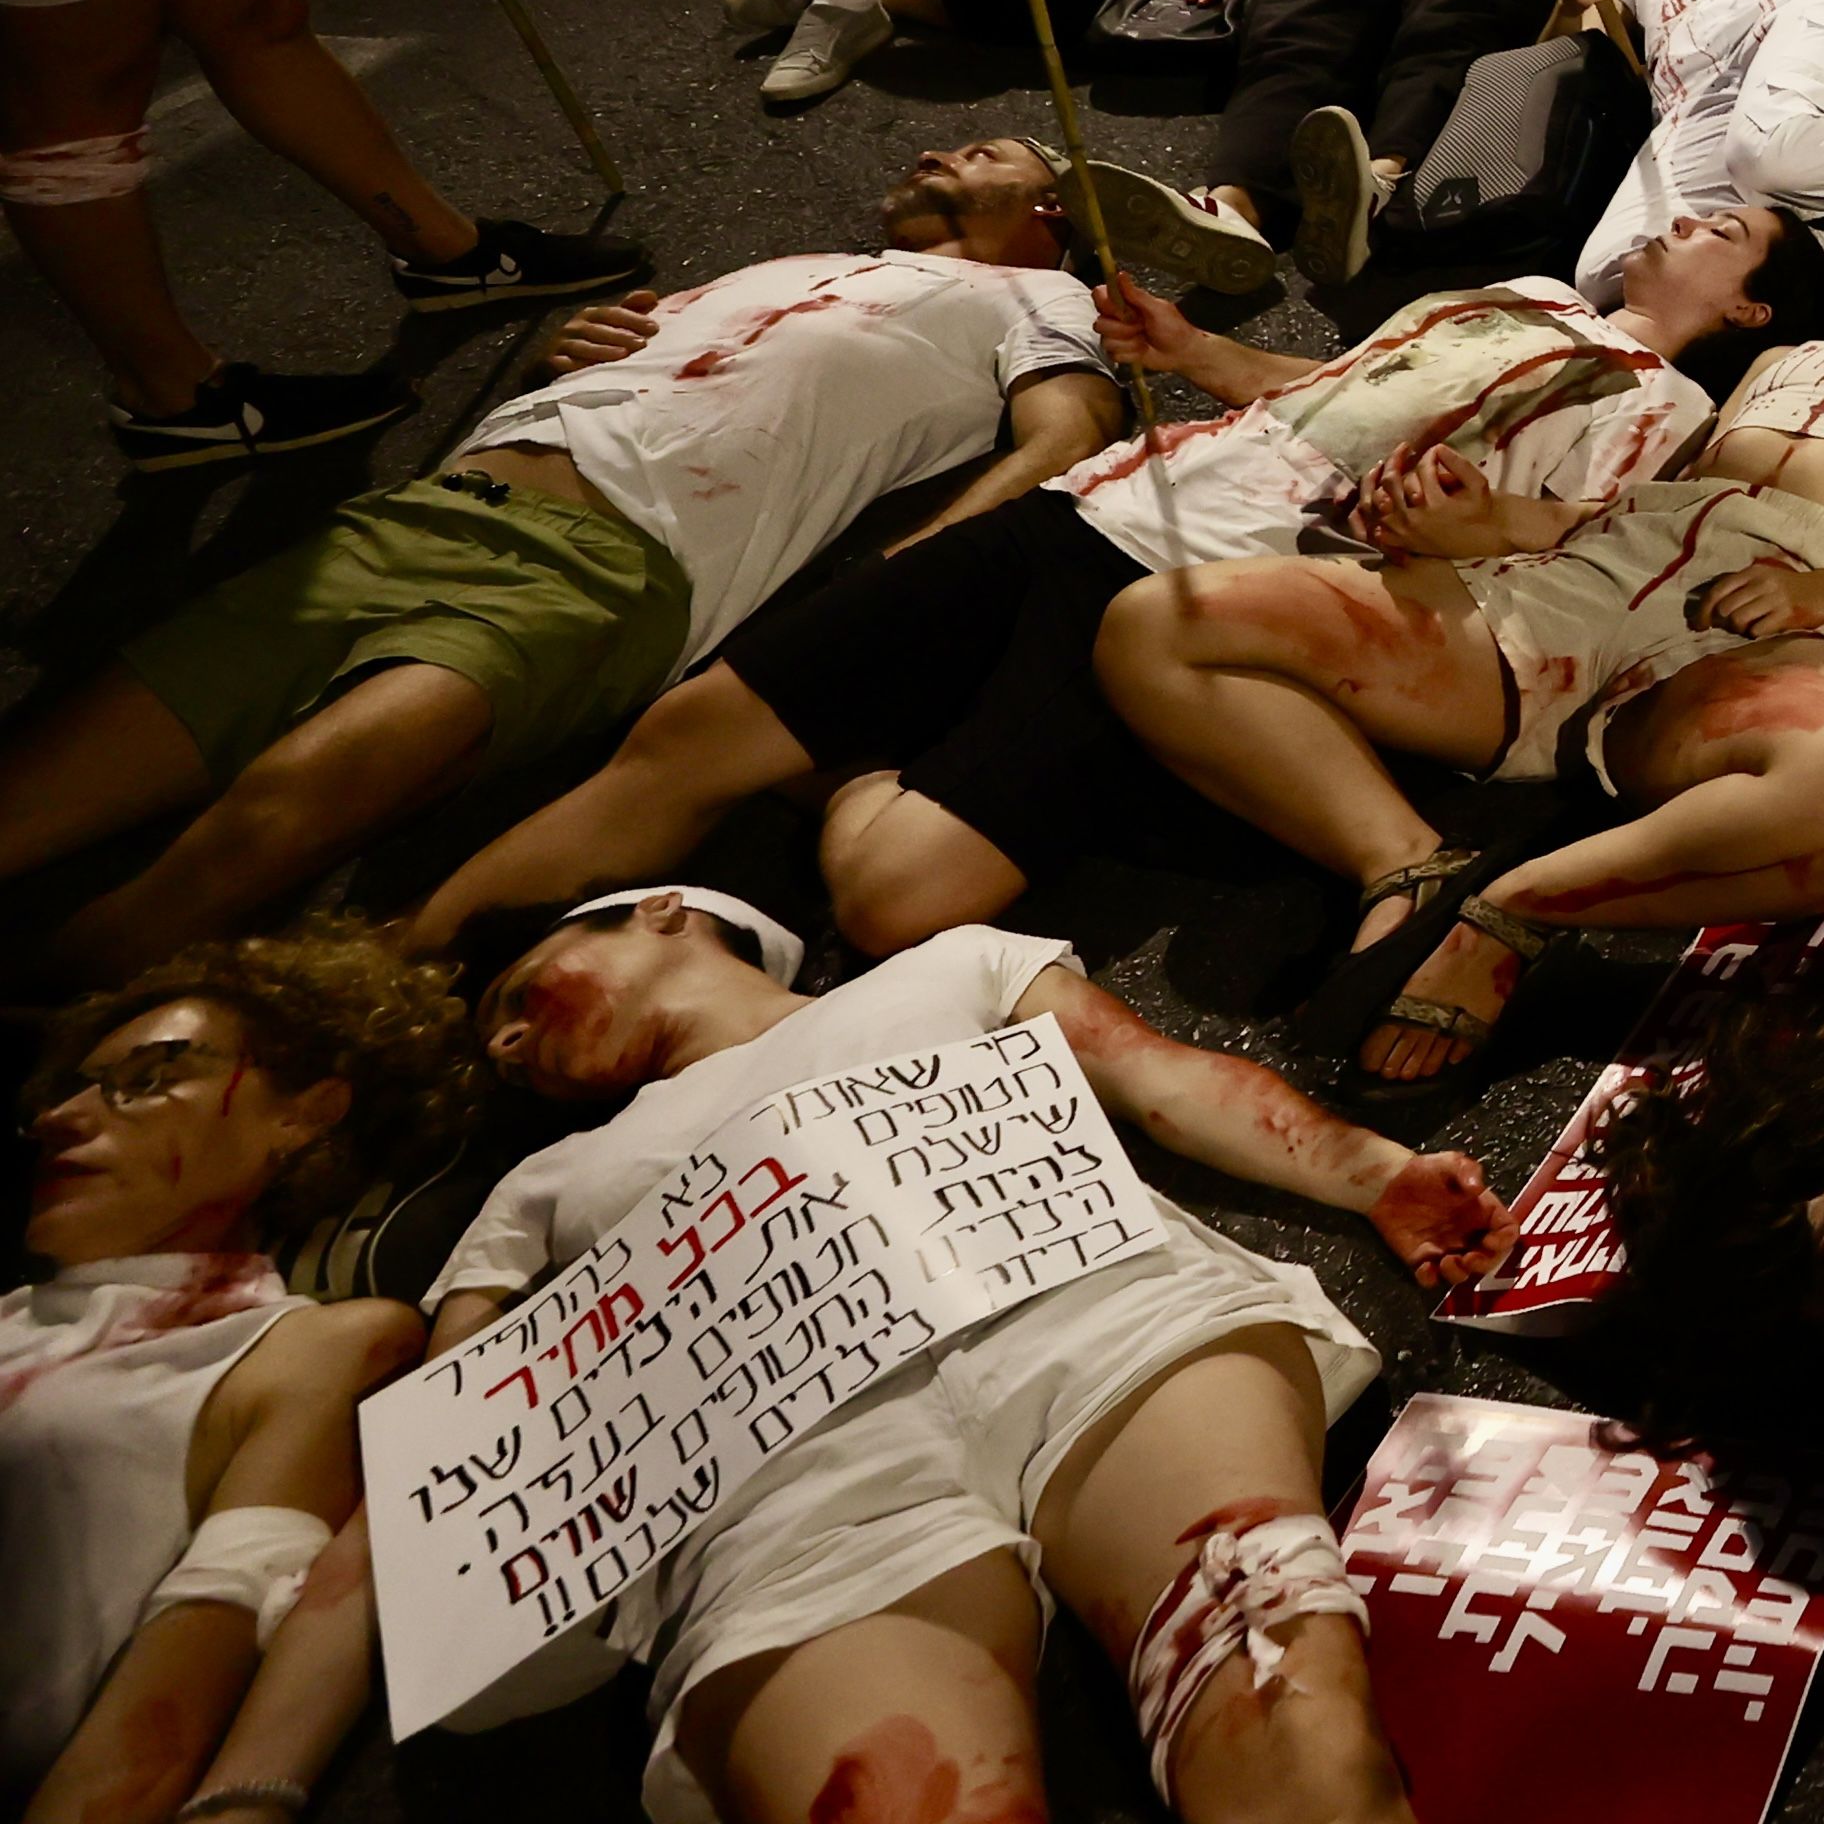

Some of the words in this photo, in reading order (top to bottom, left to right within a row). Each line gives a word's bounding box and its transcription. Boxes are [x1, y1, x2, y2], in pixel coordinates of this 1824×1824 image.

[749, 1053, 943, 1137] שאומר
[970, 1028, 1043, 1067] מי
[853, 1062, 1063, 1147] חטופים
[885, 1096, 1080, 1186] שישלח
[656, 1153, 809, 1293] בכל
[657, 1150, 729, 1228] לא
[745, 1171, 853, 1284] את
[918, 1139, 1105, 1236] להיות
[686, 1214, 890, 1380] חטופים
[975, 1217, 1154, 1312] בדיוק
[484, 1282, 645, 1411] מחיר
[550, 1276, 718, 1442] הילדים
[669, 1267, 894, 1466] החטופים
[748, 1303, 937, 1456] לילדים
[409, 1424, 523, 1523] שלו
[500, 1466, 641, 1604] שווים
